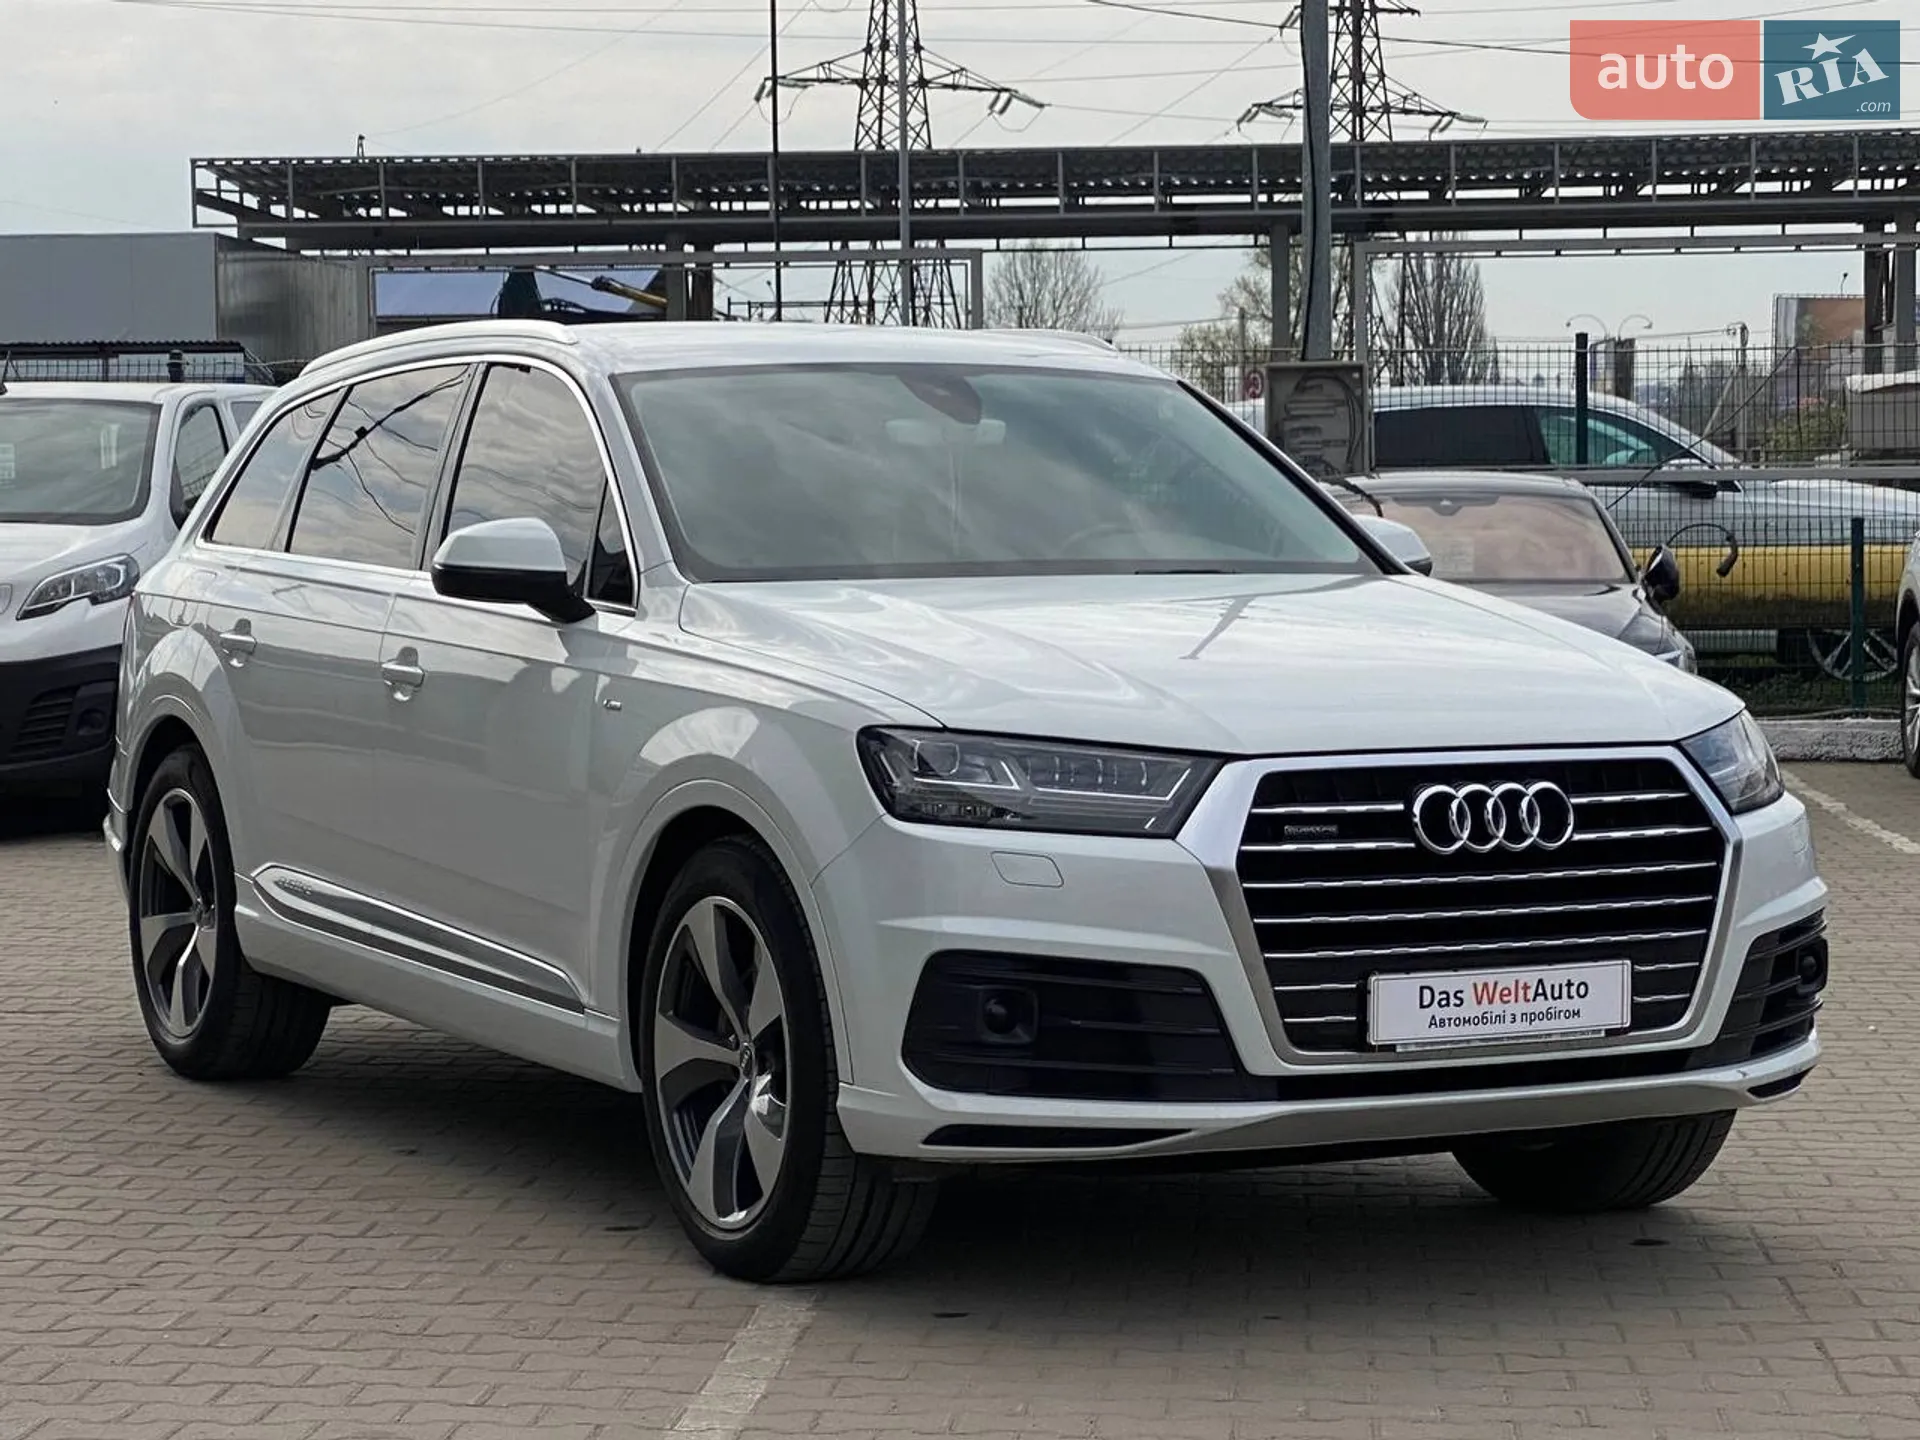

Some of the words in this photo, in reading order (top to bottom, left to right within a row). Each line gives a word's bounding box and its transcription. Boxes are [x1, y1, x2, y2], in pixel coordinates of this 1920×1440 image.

[1418, 985, 1464, 1009] Das
[1472, 978, 1589, 1006] WeltAuto
[1428, 1010, 1506, 1029] Автомобілі
[1510, 1012, 1517, 1024] з
[1520, 1006, 1581, 1026] пробігом
